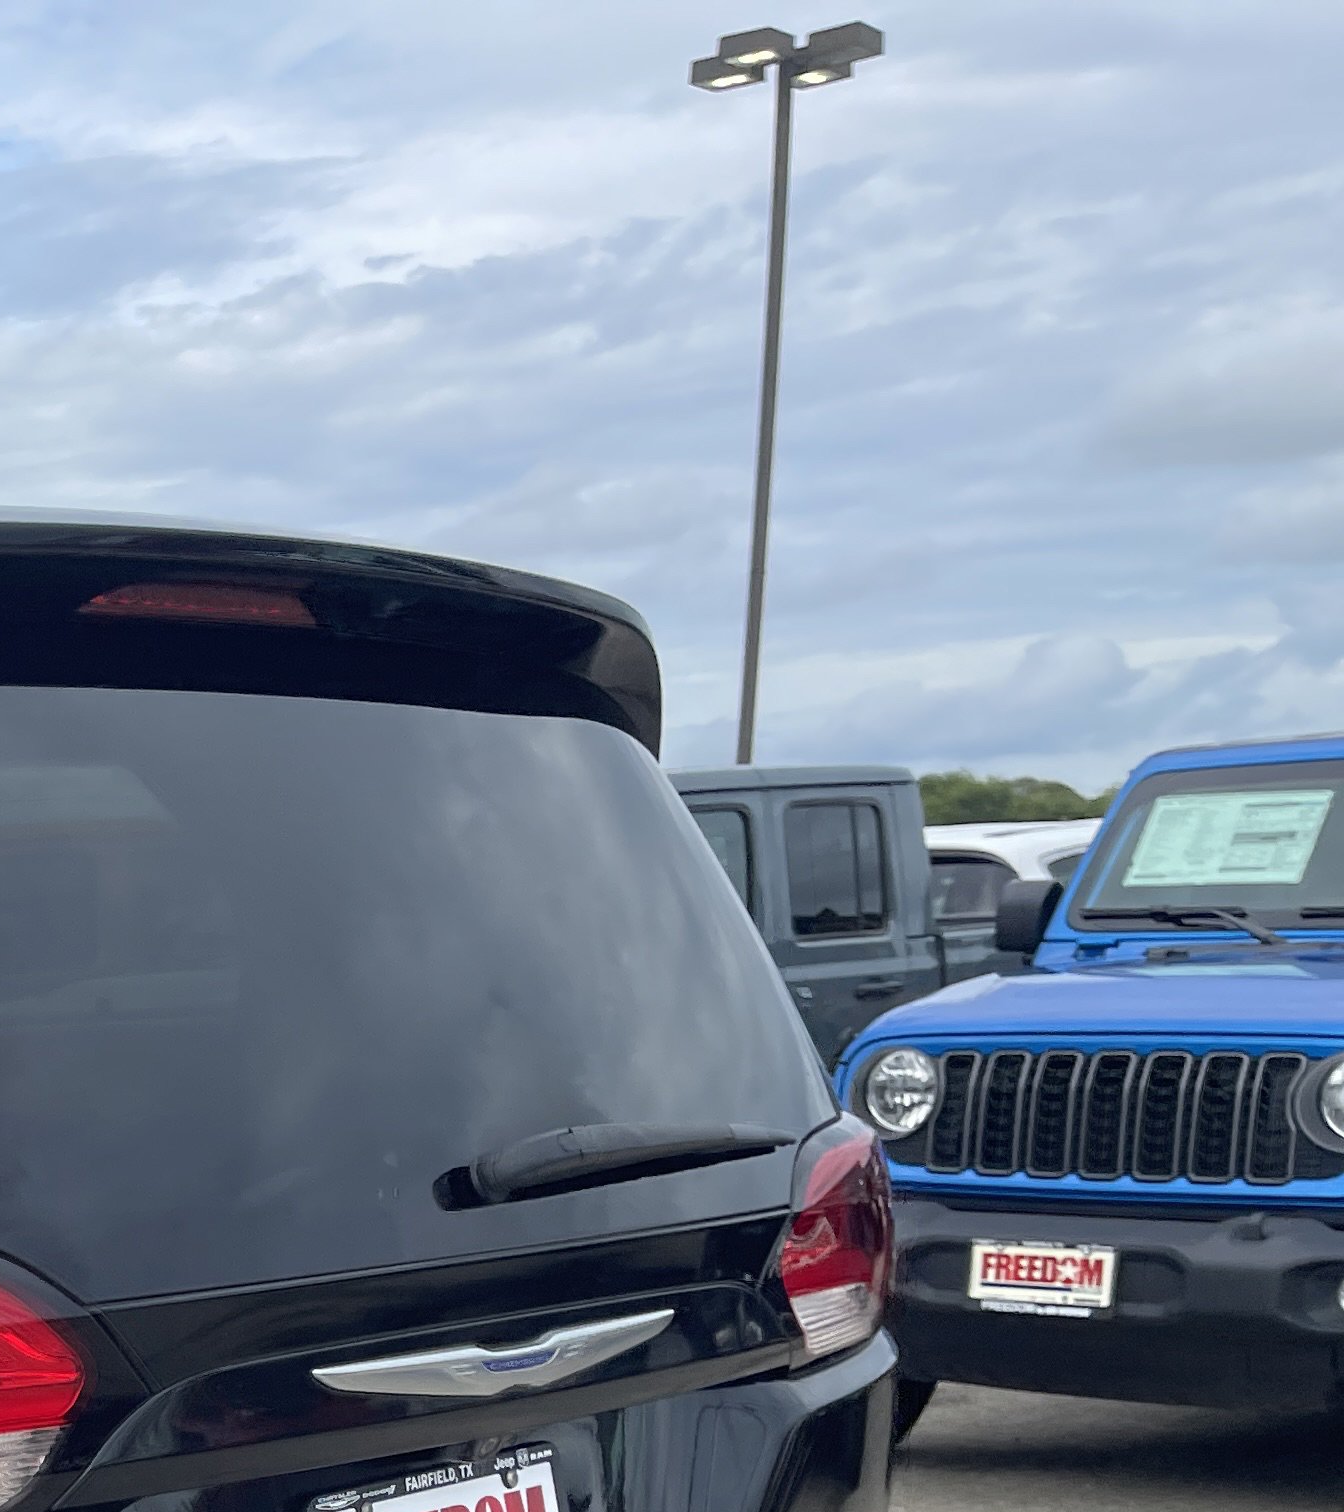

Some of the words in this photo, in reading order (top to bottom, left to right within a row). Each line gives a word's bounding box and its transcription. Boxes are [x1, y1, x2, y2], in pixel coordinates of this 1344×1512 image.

[981, 1253, 1103, 1287] FREEDOM
[405, 1467, 459, 1491] FAIRFIELD,
[459, 1463, 473, 1478] TX
